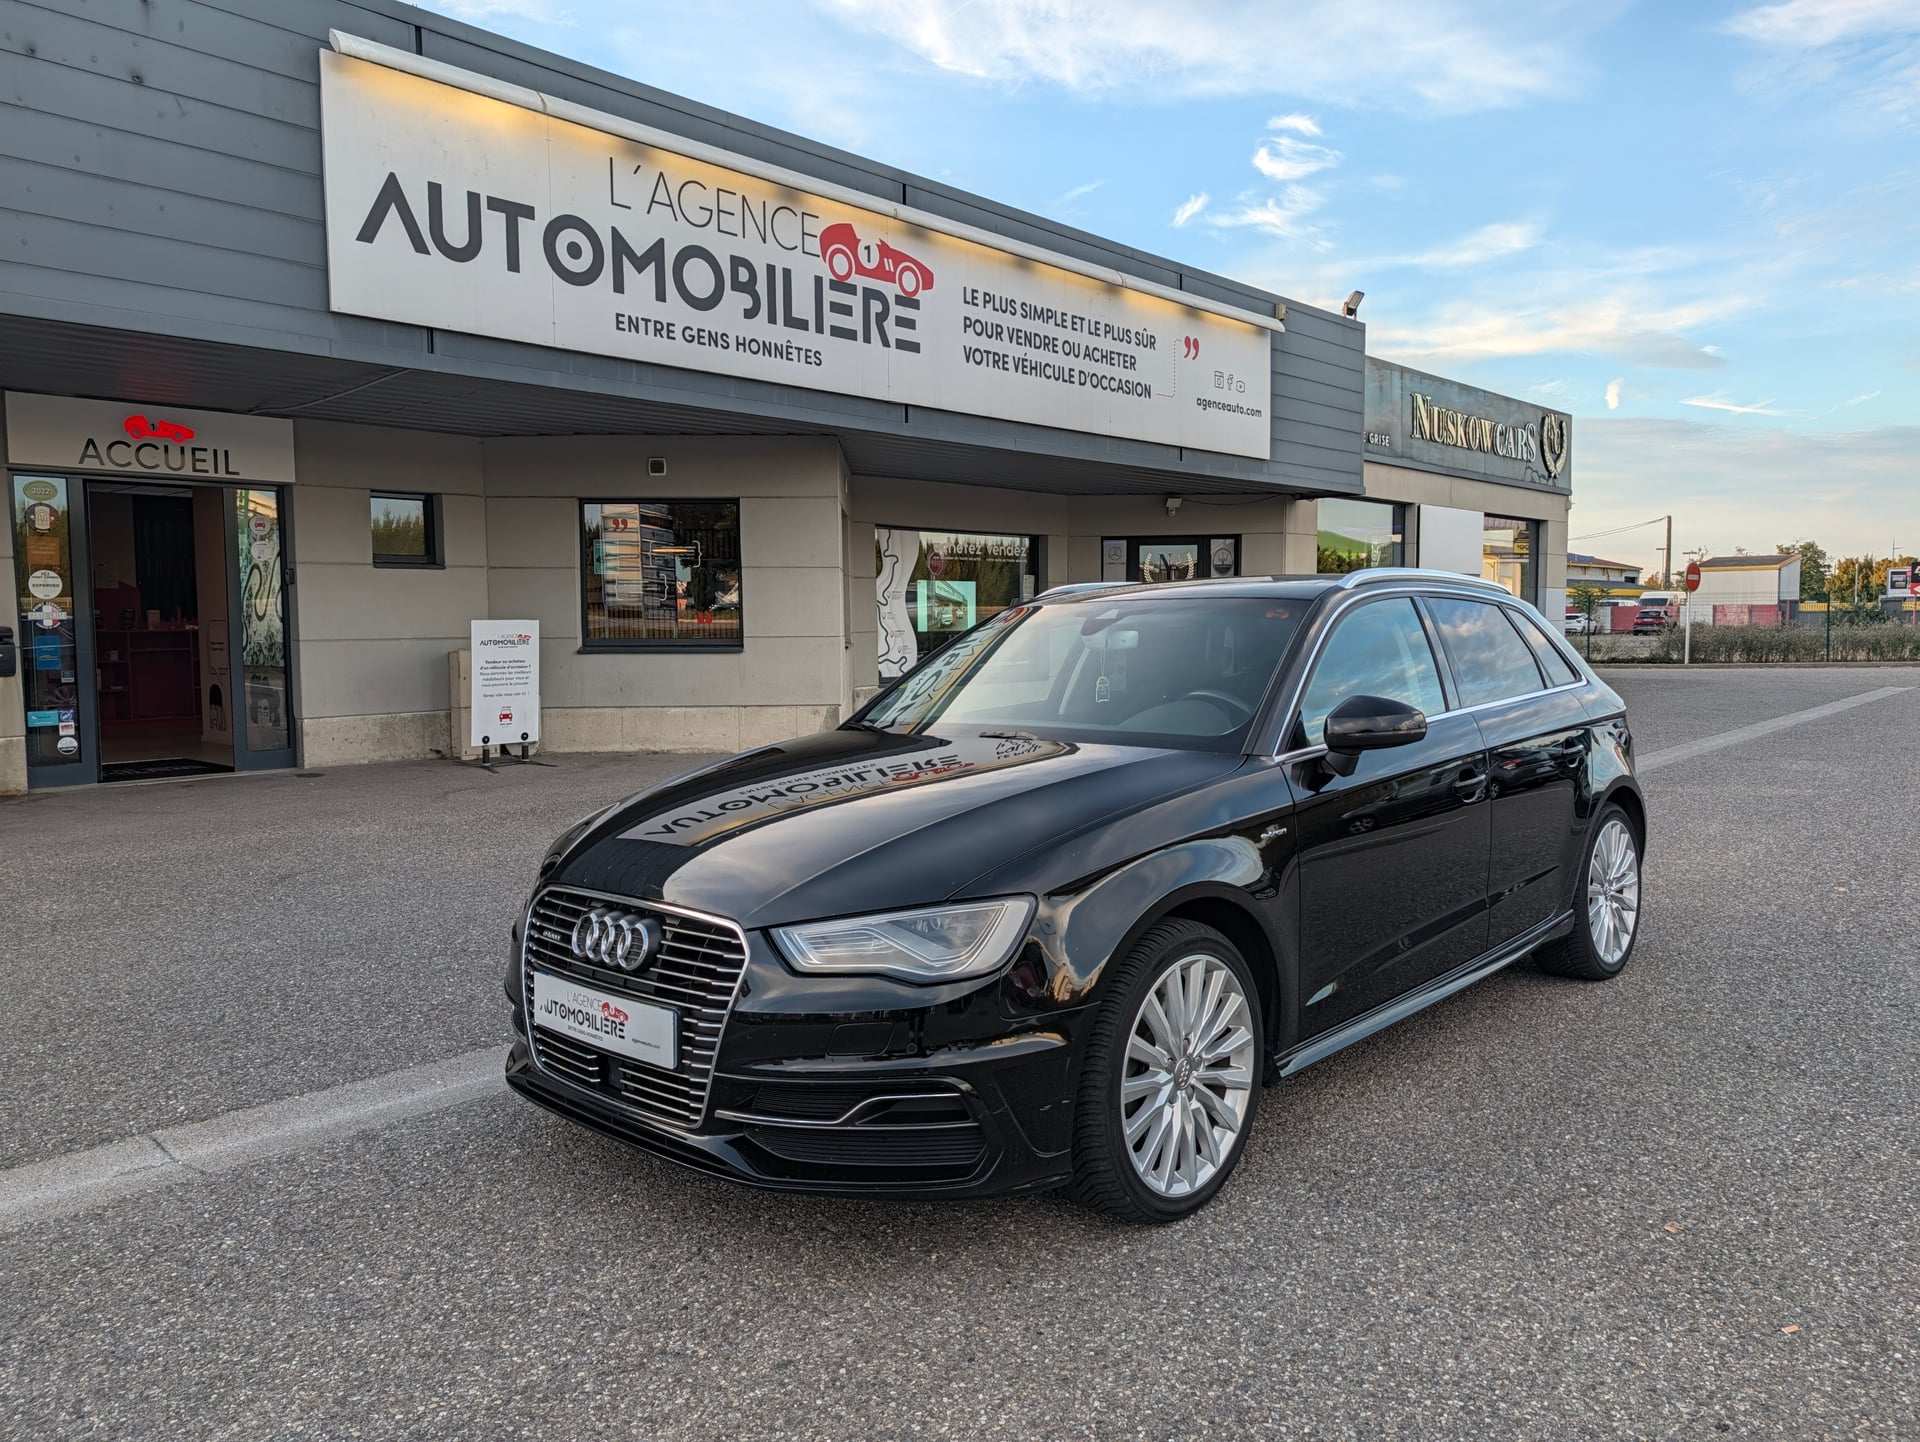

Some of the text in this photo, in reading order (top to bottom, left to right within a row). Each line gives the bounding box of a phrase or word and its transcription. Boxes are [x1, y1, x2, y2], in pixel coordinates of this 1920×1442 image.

[609, 156, 820, 258] L'AGENCE
[615, 312, 823, 367] ENTRE GENS HONNÊTES
[963, 286, 1157, 351] LE PLUS SIMPLE ET LE PLUS SÛR
[963, 315, 1137, 372] POUR VENDRE OU ACHETER
[963, 344, 1152, 400] VOTRE VÉHICULE D'OCCASION
[1196, 397, 1263, 418] agenceauto.com
[78, 437, 241, 476] ACCUEIL
[1369, 432, 1390, 447] GRISE
